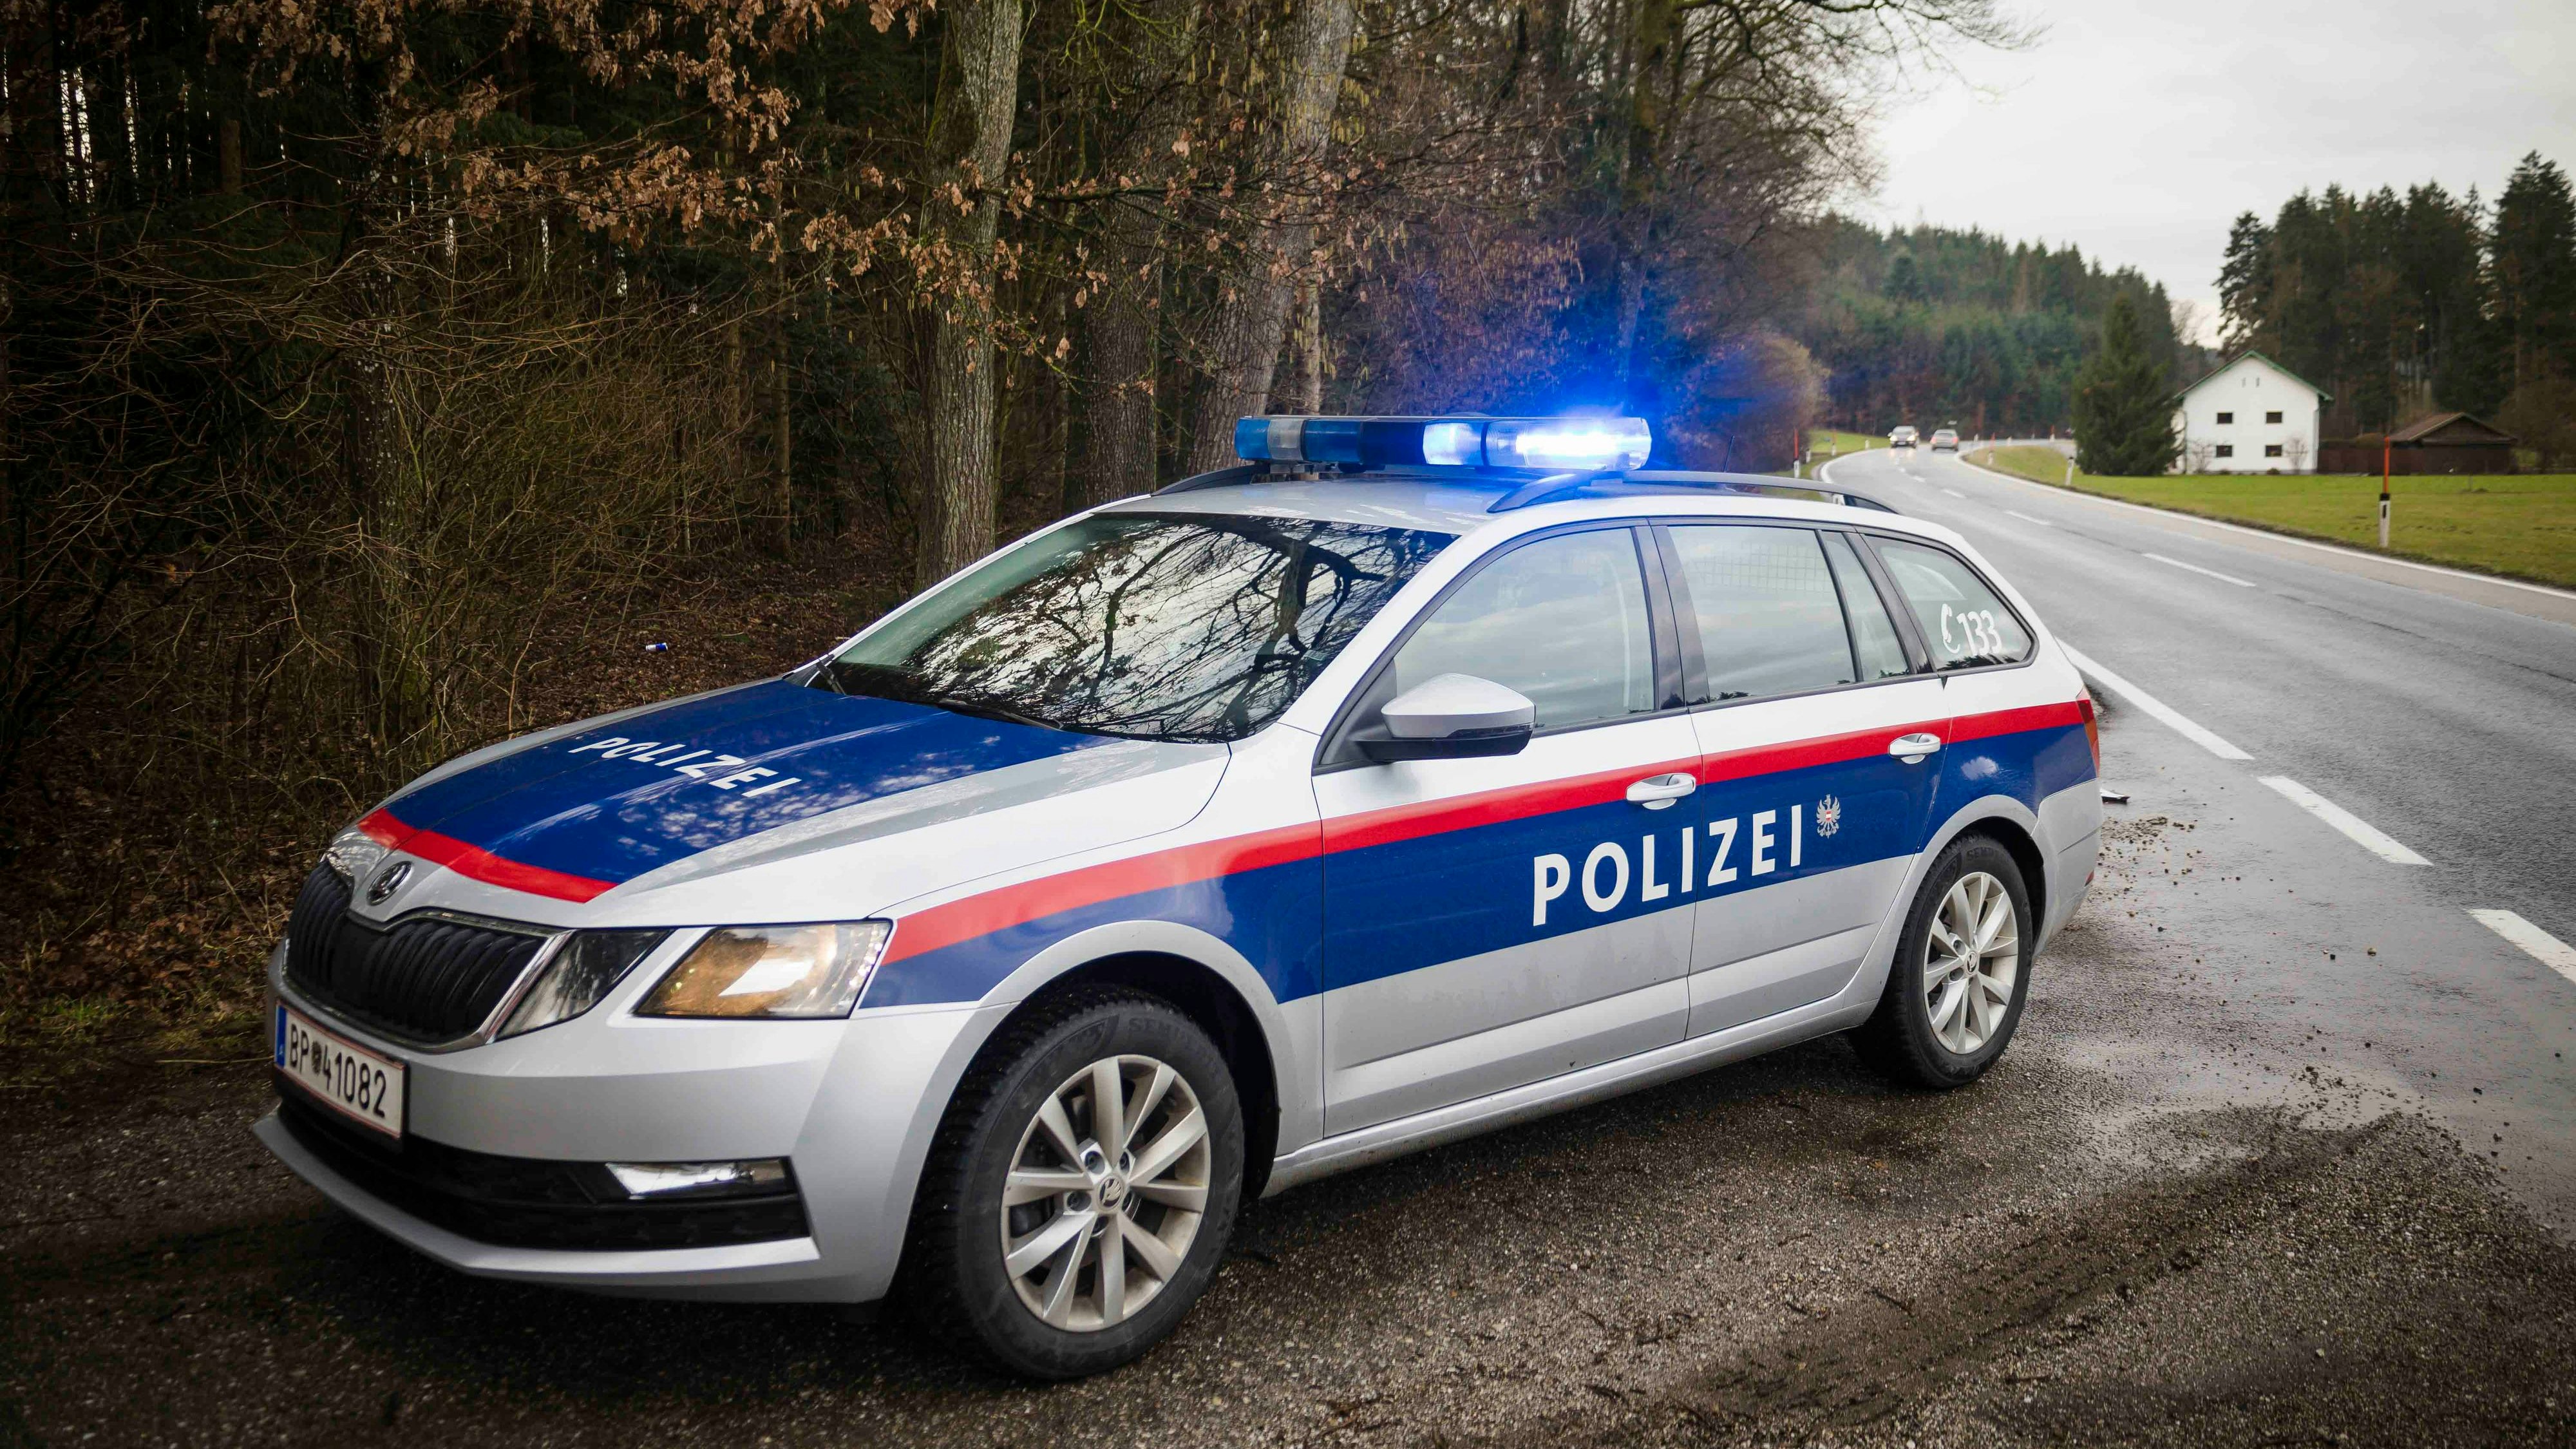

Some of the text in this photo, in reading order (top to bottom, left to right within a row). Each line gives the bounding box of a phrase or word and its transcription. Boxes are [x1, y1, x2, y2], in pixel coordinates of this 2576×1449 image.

[1956, 610, 2002, 656] 133
[567, 737, 802, 797] POLIZEI
[1533, 804, 1801, 927] POLIZEI
[290, 1023, 386, 1118] BP 41082
